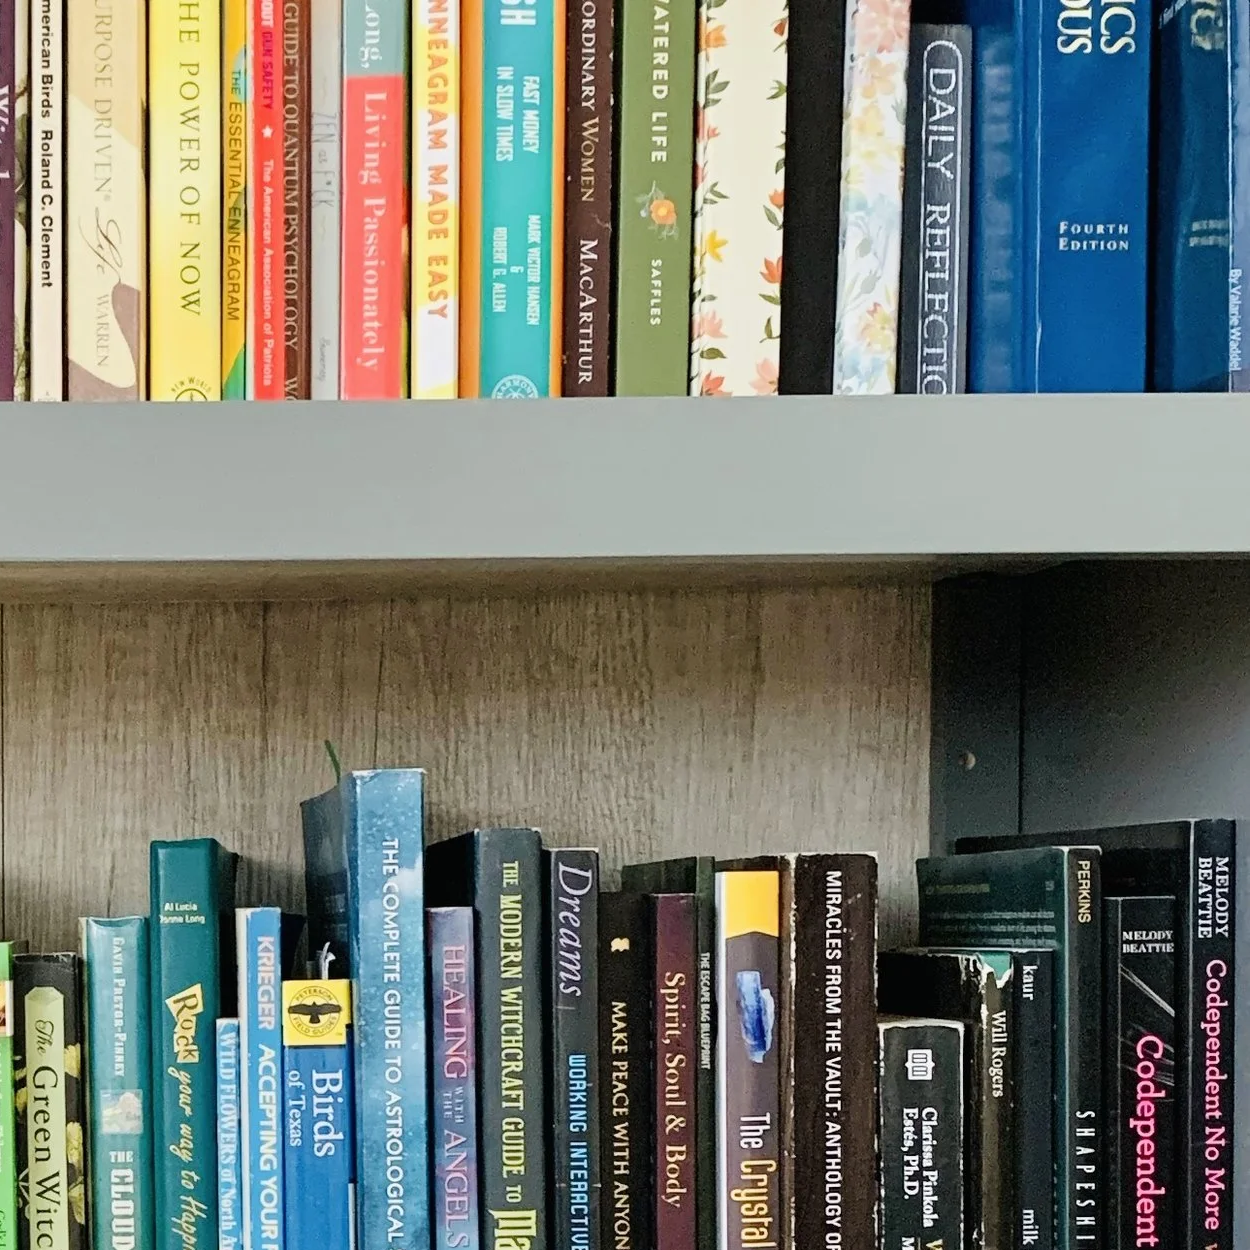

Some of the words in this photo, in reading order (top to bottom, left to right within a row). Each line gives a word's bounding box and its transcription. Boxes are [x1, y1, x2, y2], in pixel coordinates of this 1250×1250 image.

[41, 74, 54, 118] Birds
[496, 66, 514, 79] IN
[496, 85, 514, 120] SLOW
[523, 76, 539, 104] FAST
[179, 62, 200, 174] POWER
[359, 92, 388, 186] Living
[496, 125, 513, 162] TIMES
[522, 110, 539, 154] MONEY
[650, 111, 668, 163] LIFE
[927, 67, 957, 180] DAILY
[41, 129, 54, 189] Roland
[580, 117, 600, 202] WOMEN
[41, 194, 54, 211] C.
[179, 185, 201, 226] OF
[427, 163, 449, 241] MADE
[1058, 221, 1130, 236] FOURTH
[41, 215, 54, 289] Clement
[1058, 237, 1130, 251] EDITION
[180, 242, 202, 316] NOW
[357, 196, 388, 372] Passionately
[427, 255, 448, 319] EASY
[649, 258, 662, 326] SAFFLES
[381, 837, 399, 878] THE
[824, 870, 843, 960] MIRACLES
[1077, 860, 1091, 923] PERKINS
[381, 879, 401, 983] COMPLETE
[557, 861, 592, 998] Dreams
[1122, 930, 1174, 942] MELODY
[1122, 942, 1174, 953] BEATTIE
[659, 971, 687, 1046] Spirit,
[824, 964, 843, 1015] FROM
[384, 989, 402, 1051] GUIDE
[824, 1018, 843, 1053] THE
[384, 1058, 403, 1083] TO
[664, 1051, 687, 1109] Soul
[824, 1056, 843, 1116] VAULT:
[288, 1098, 302, 1147] Texas
[311, 1069, 345, 1159] Birds
[664, 1113, 687, 1135] &
[1129, 1034, 1167, 1250] Codependent
[384, 1089, 406, 1244] ASTROLOGICAL
[660, 1144, 688, 1209] Body
